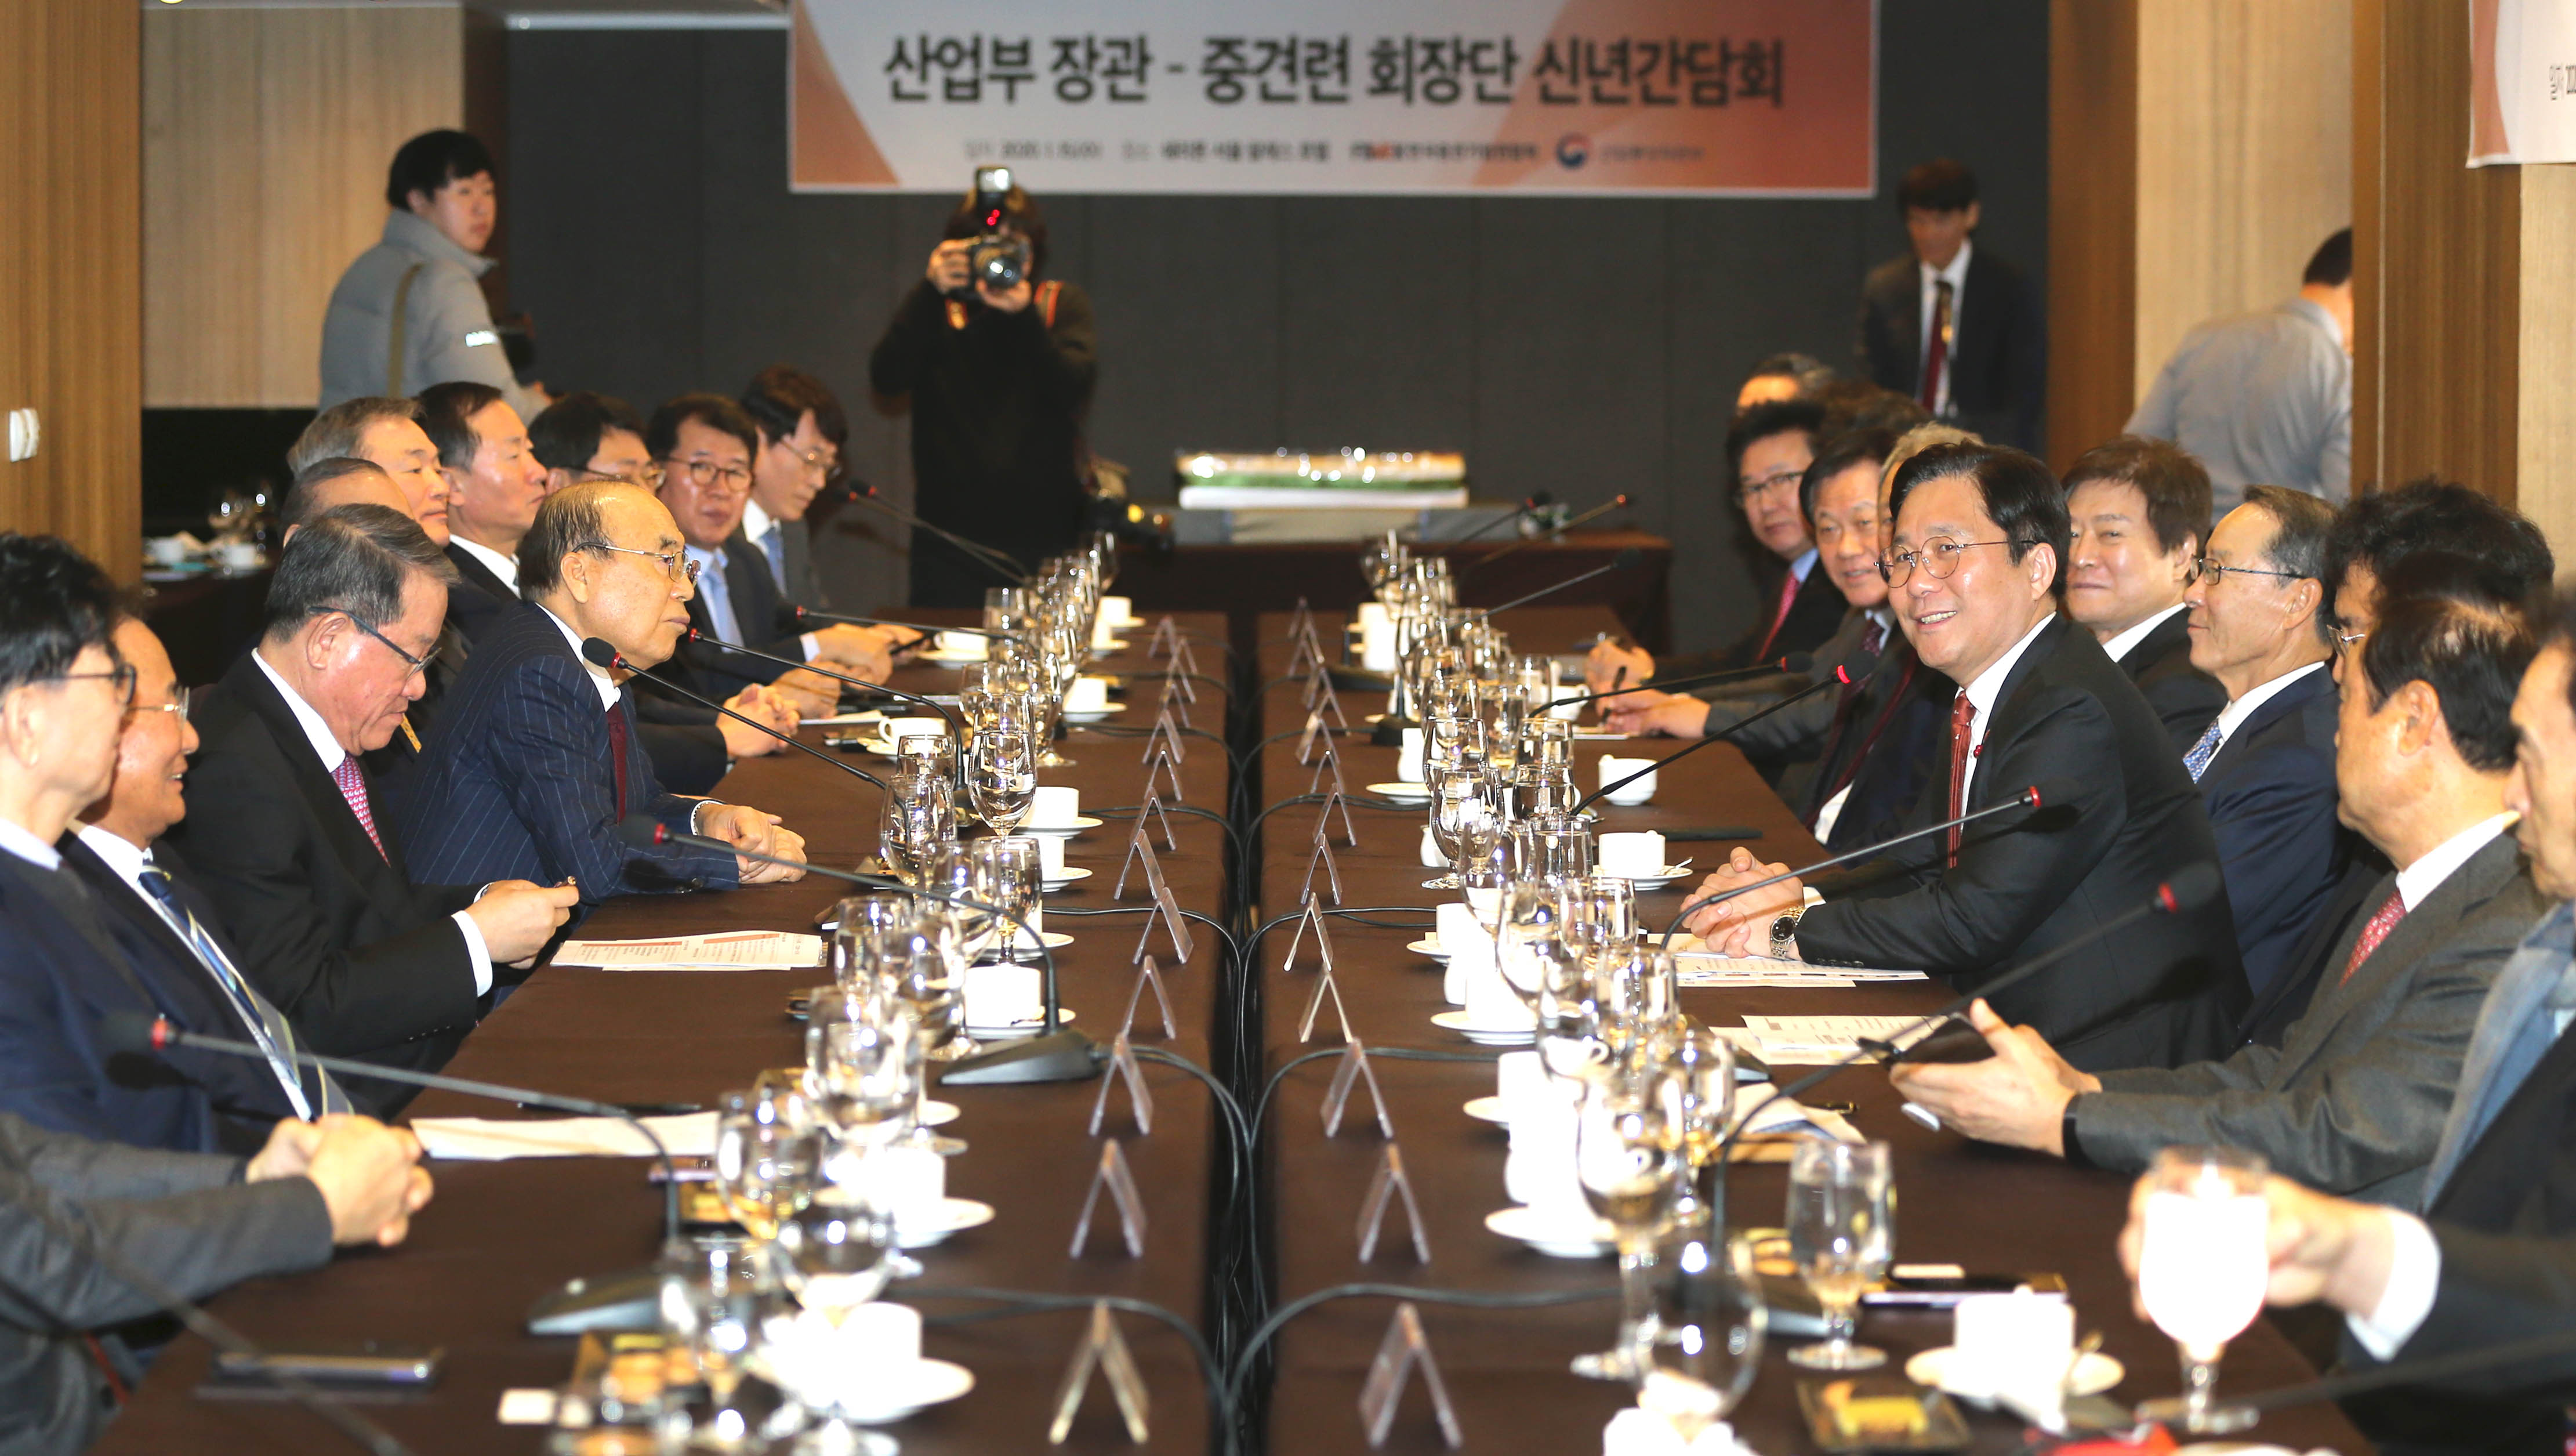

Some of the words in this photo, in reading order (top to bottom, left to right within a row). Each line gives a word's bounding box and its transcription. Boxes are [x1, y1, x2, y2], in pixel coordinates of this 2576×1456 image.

[883, 34, 1035, 104] 산업부
[1050, 34, 1153, 104] 장관
[1200, 37, 1350, 104] 중견련
[1366, 35, 1518, 106] 회장단
[1532, 36, 1783, 107] 신년간담회
